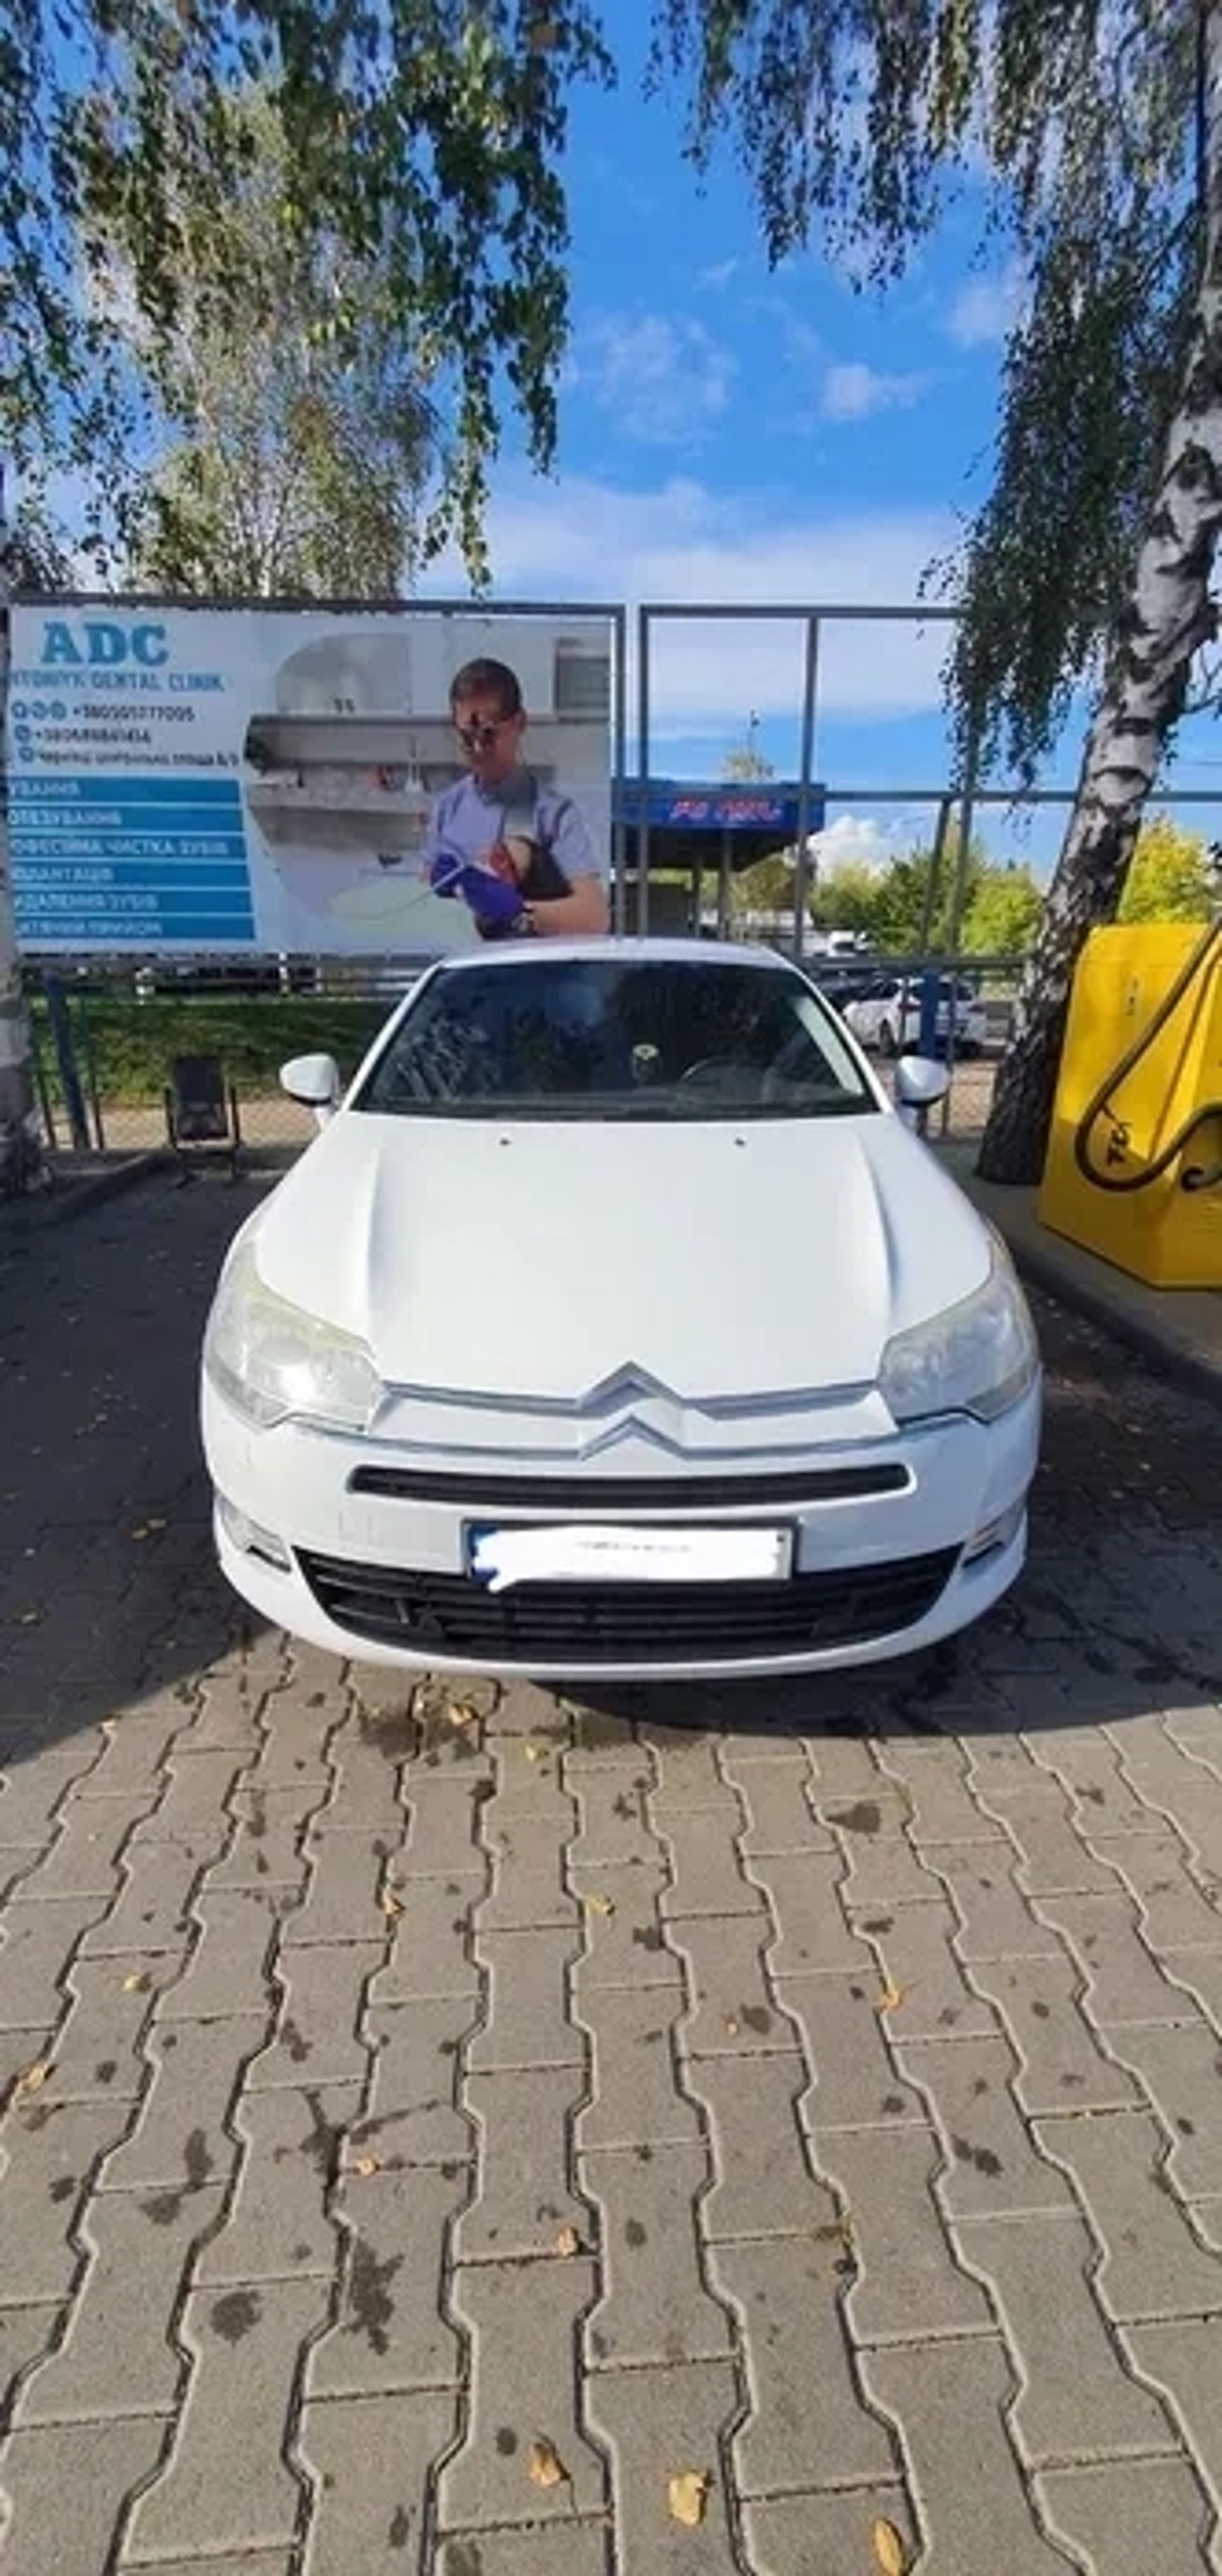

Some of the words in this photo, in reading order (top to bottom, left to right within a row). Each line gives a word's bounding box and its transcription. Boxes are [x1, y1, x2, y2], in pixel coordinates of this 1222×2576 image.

[41, 620, 169, 666] ADC
[91, 671, 162, 690] DENTAL
[106, 838, 176, 856] ЧИСТКА
